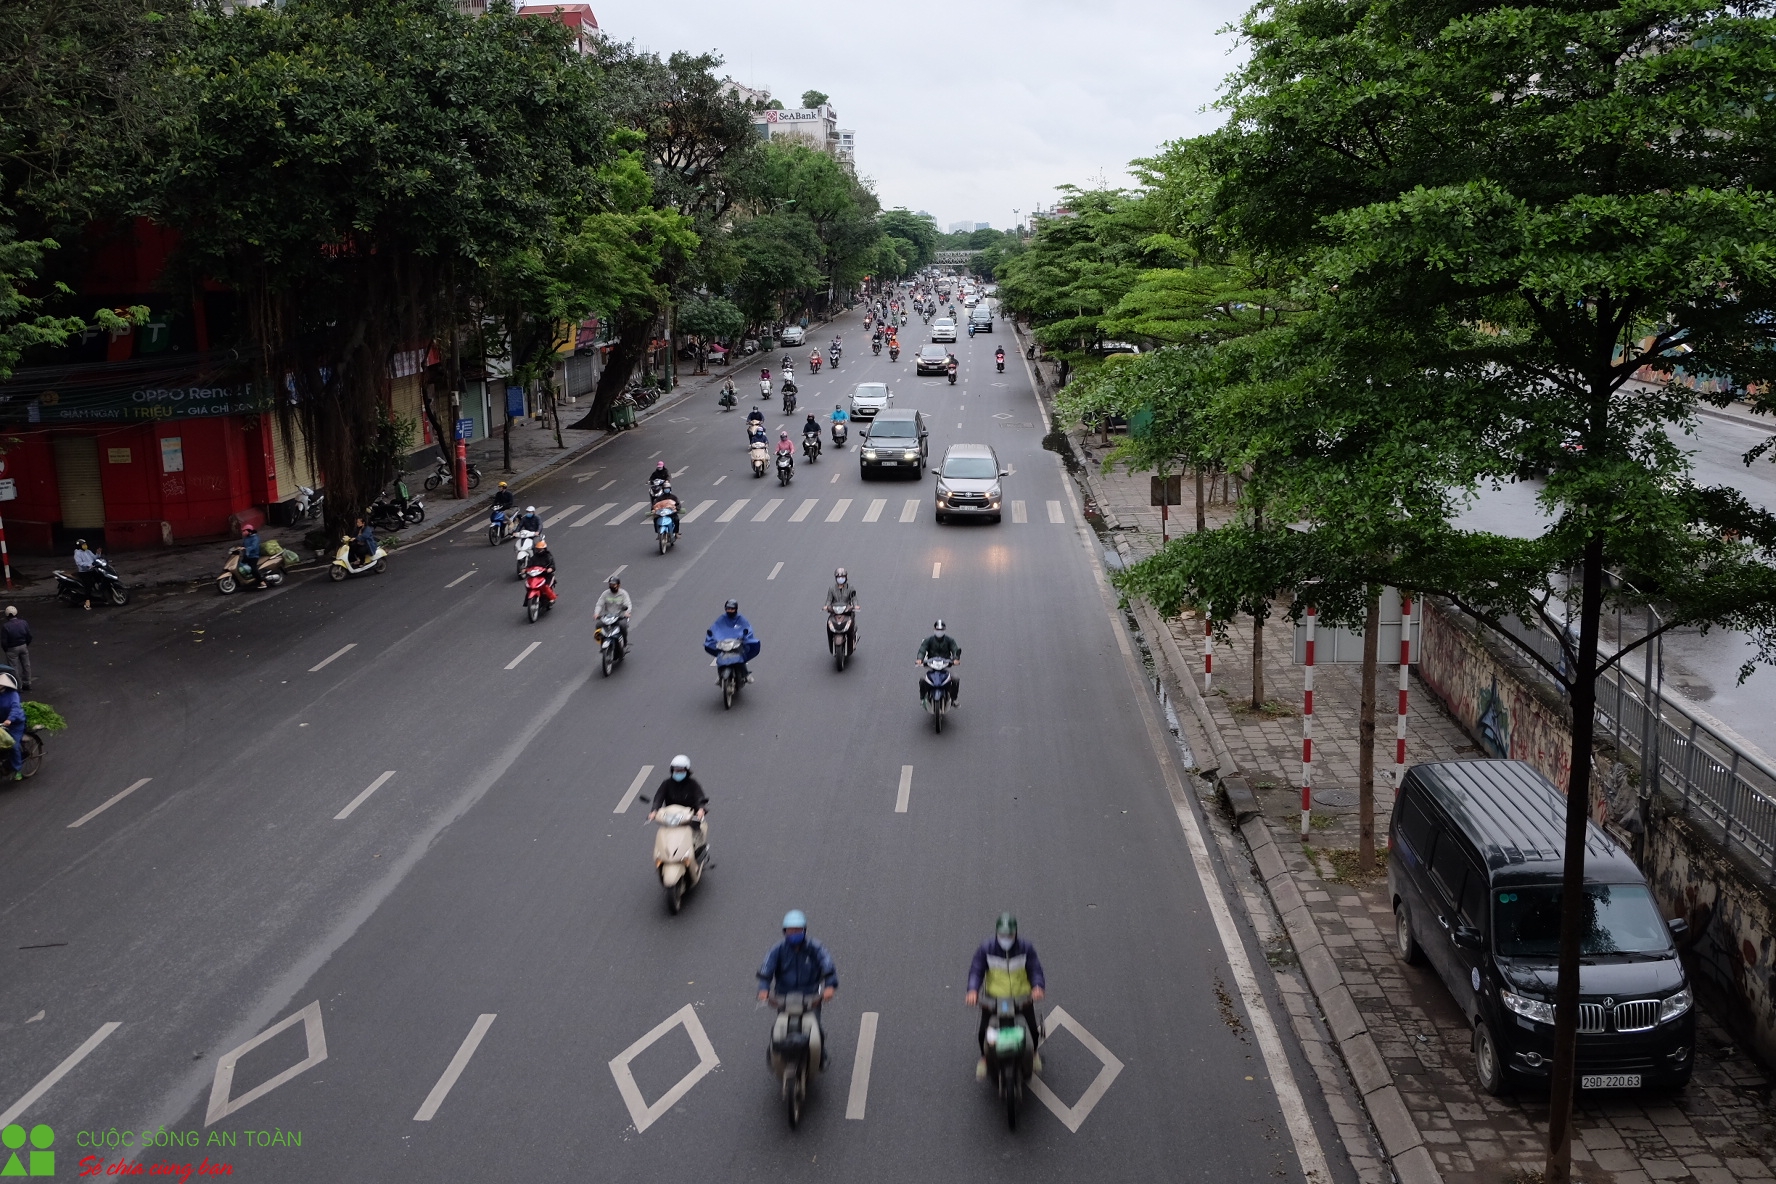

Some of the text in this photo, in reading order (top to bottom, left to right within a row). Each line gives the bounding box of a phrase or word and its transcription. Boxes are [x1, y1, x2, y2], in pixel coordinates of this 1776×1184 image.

[779, 111, 817, 121] SeABank
[132, 388, 185, 402] OPPO
[91, 409, 120, 418] NGAY
[123, 407, 129, 417] 1
[133, 404, 173, 420] TRIỆU
[187, 405, 209, 415] GIÁ
[1583, 1076, 1640, 1088] 29D-220.63
